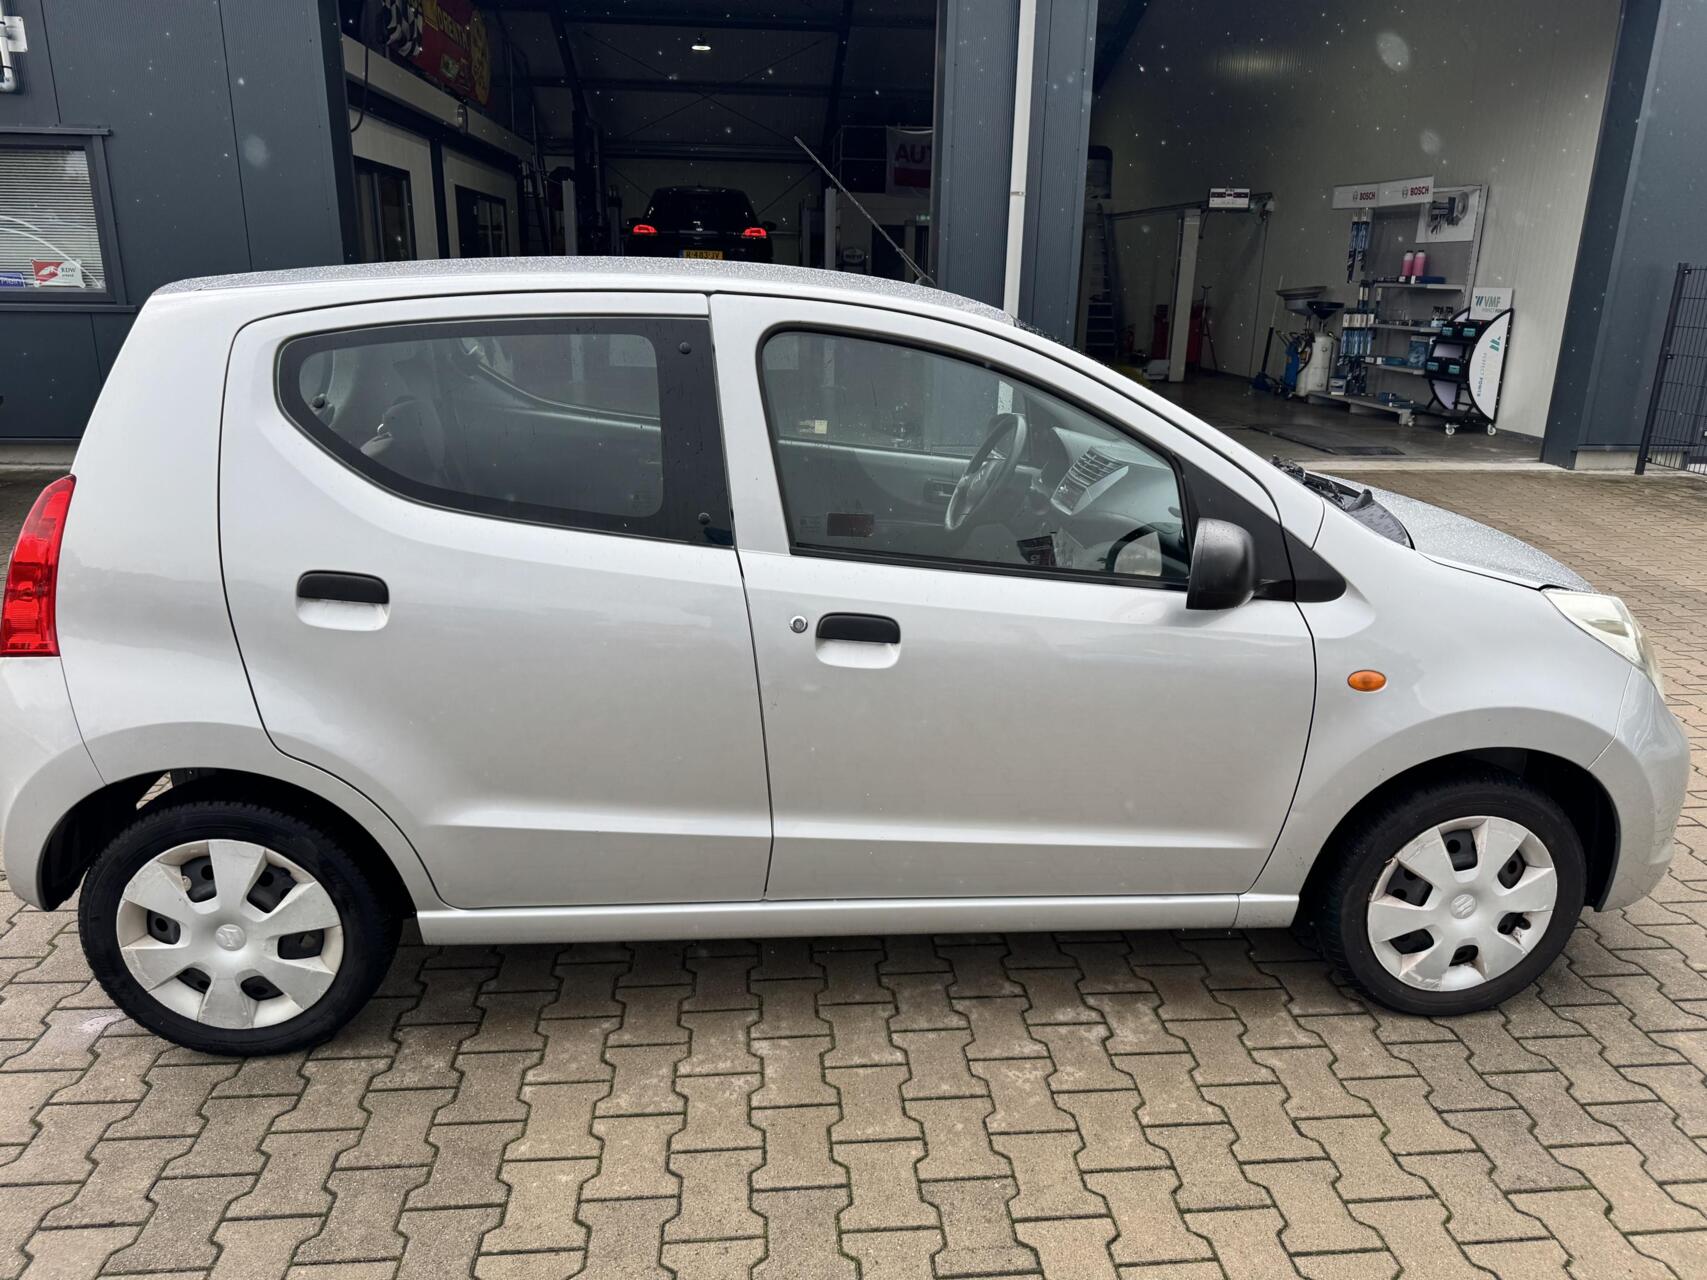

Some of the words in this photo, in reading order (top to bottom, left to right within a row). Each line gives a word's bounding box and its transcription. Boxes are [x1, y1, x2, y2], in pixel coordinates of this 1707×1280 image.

[1359, 191, 1376, 201] BOSCH
[1410, 186, 1430, 197] BOSCH
[1484, 296, 1501, 308] VMF
